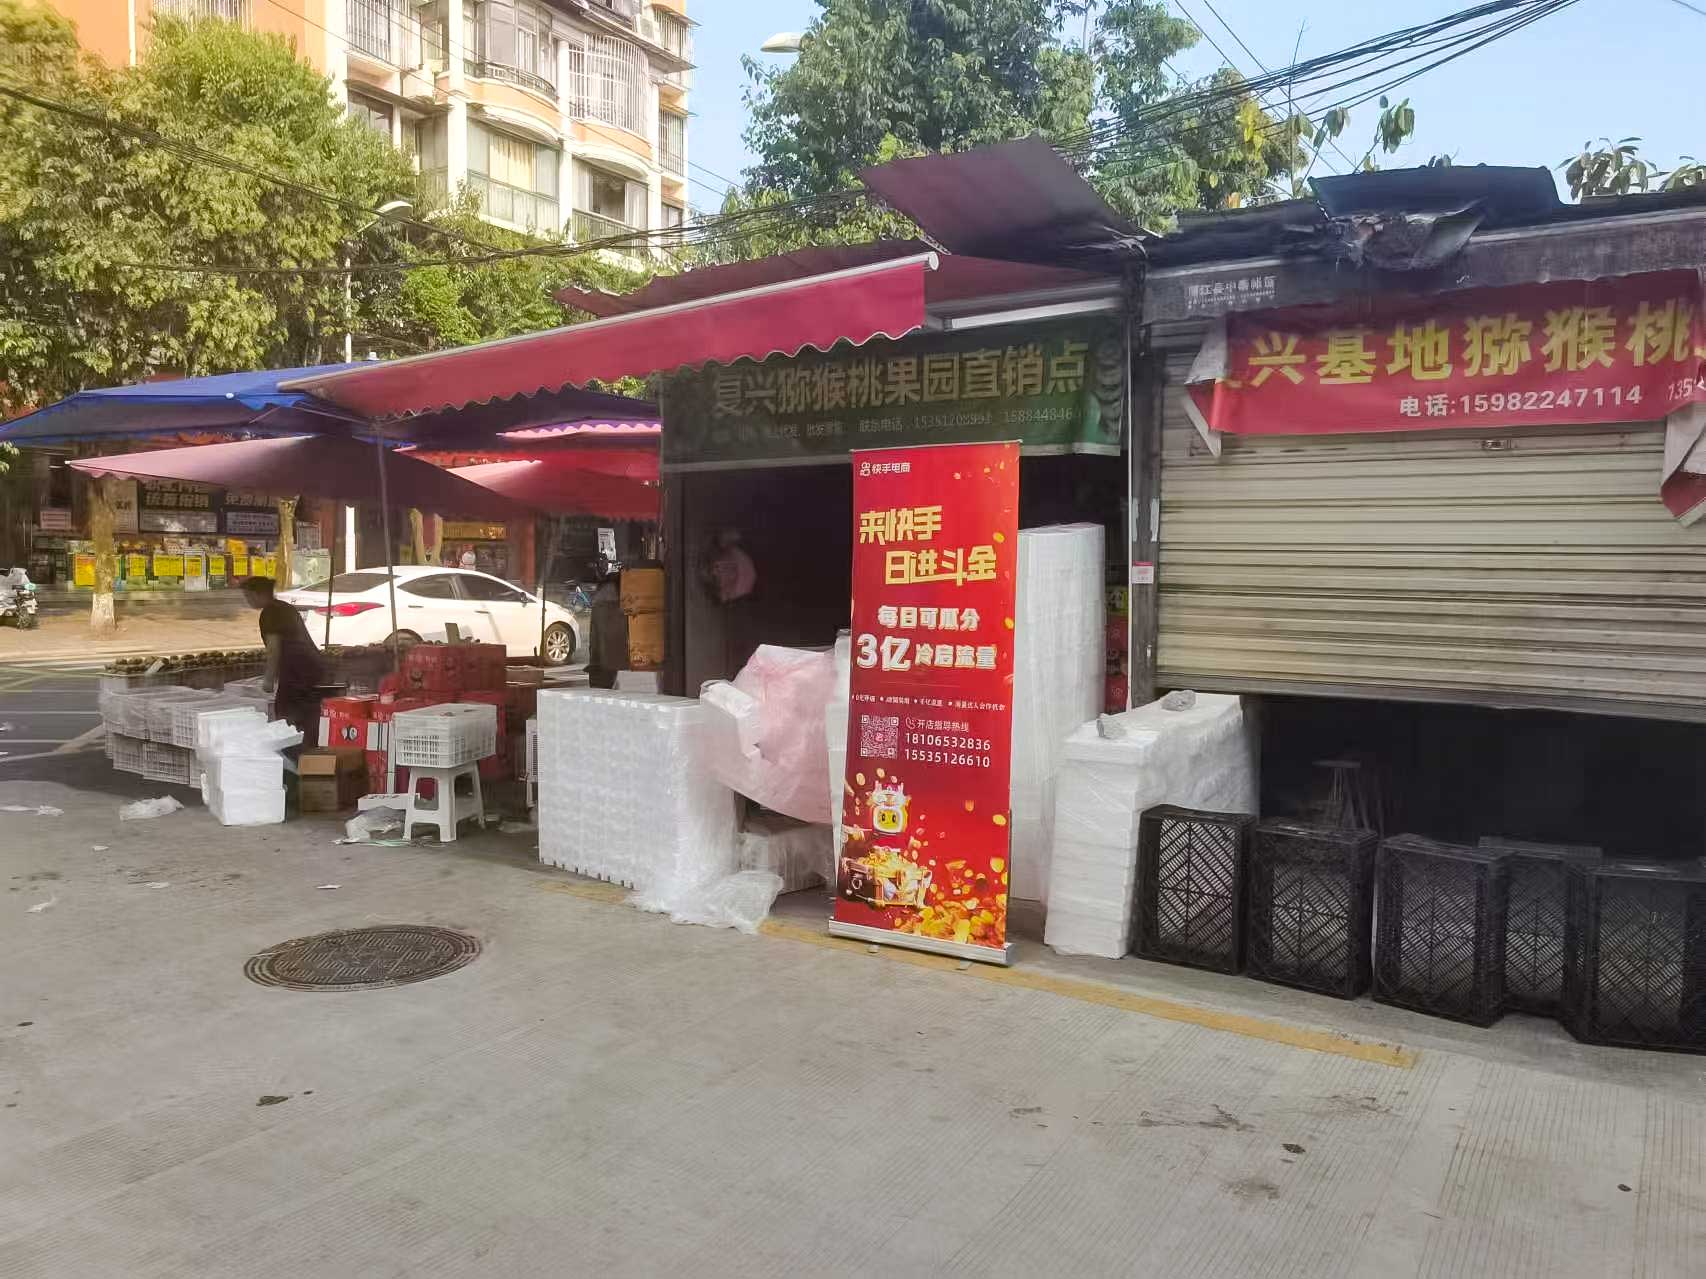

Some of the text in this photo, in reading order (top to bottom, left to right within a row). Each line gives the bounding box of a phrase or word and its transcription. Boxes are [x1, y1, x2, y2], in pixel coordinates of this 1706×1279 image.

[1218, 300, 1706, 388] 兴基地猕猴桃
[713, 342, 1089, 417] 复兴猕猴桃果园直销点
[872, 462, 911, 474] 快手电商
[859, 505, 943, 545] 来快手
[885, 545, 997, 587] 日进斗金
[878, 605, 980, 631] 每日可瓜分
[917, 719, 970, 732] 开店指导热线
[905, 732, 992, 751] 18106532836
[904, 749, 991, 768] 15535126610
